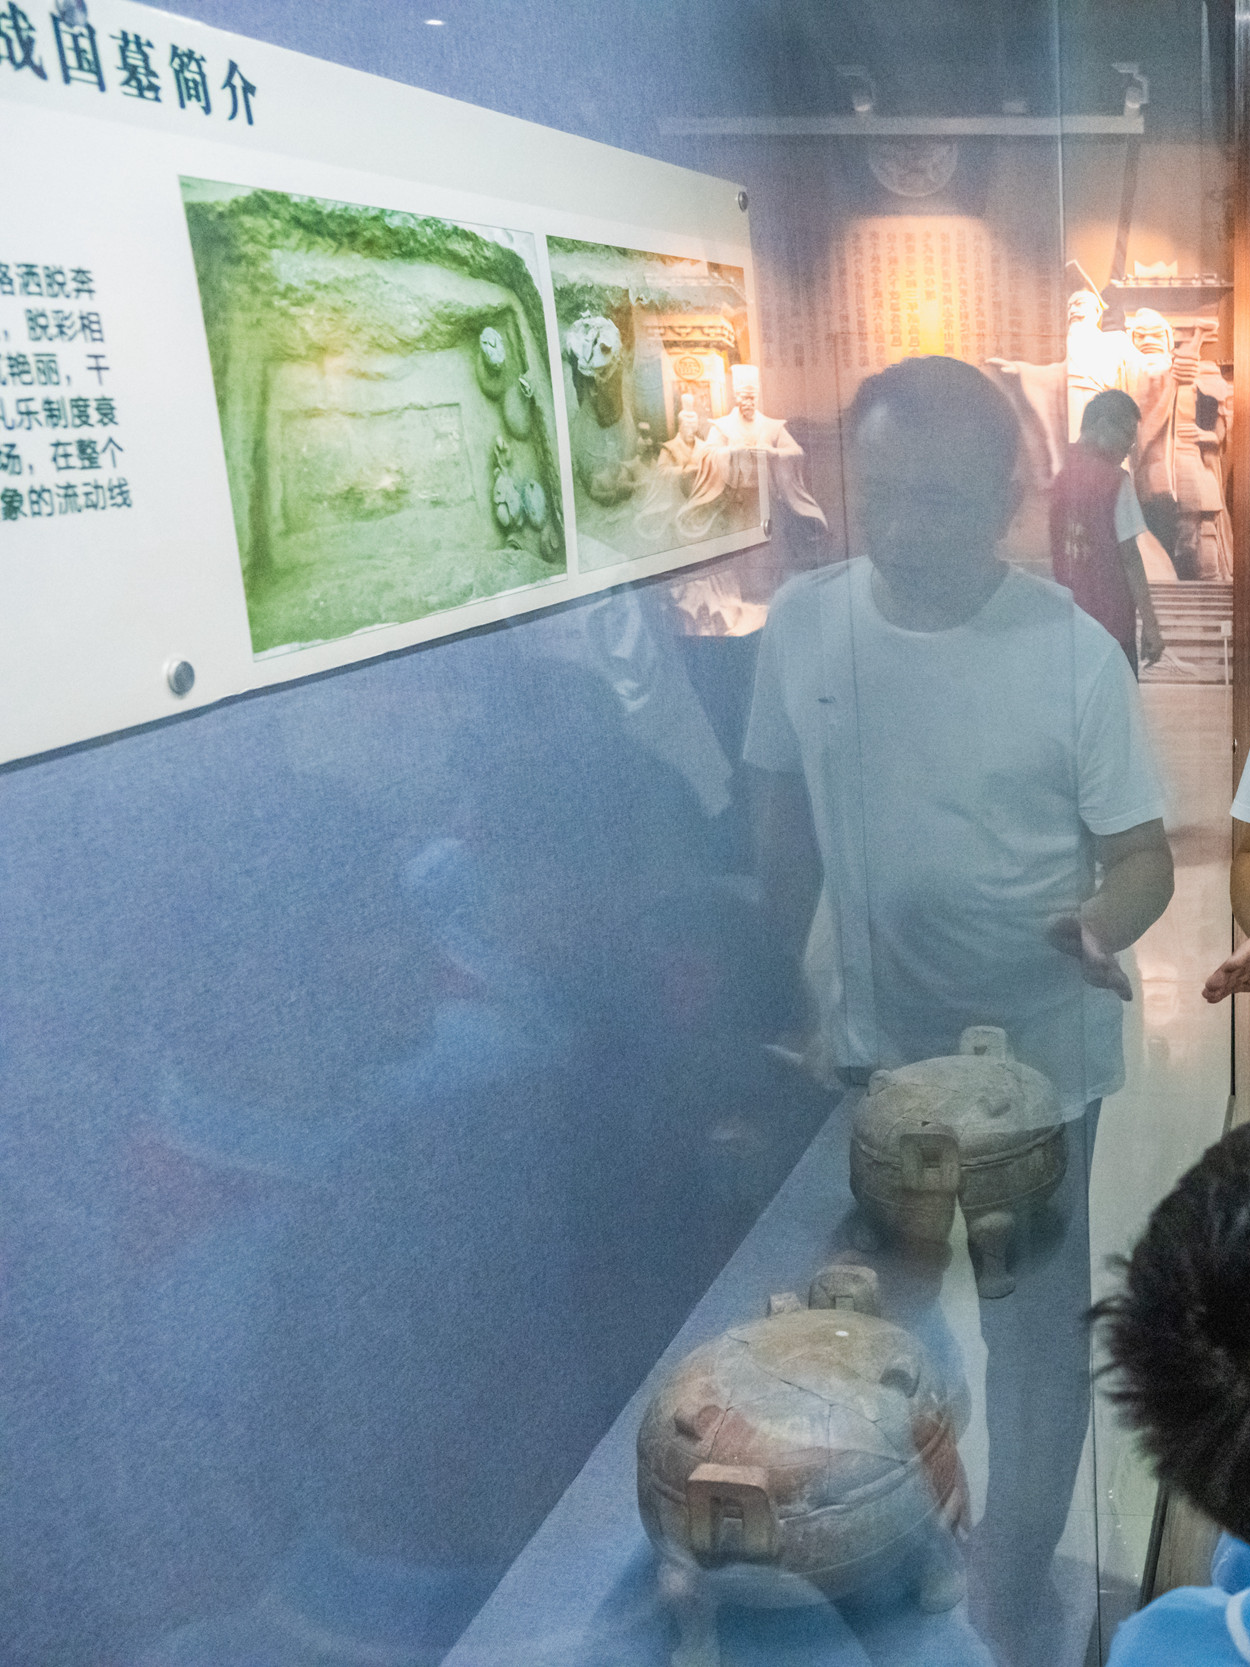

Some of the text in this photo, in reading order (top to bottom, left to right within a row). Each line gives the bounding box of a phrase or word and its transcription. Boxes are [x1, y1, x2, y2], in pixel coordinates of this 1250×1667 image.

[0, 1, 257, 126] 战国墓简介
[0, 353, 110, 386] 艳丽，干
